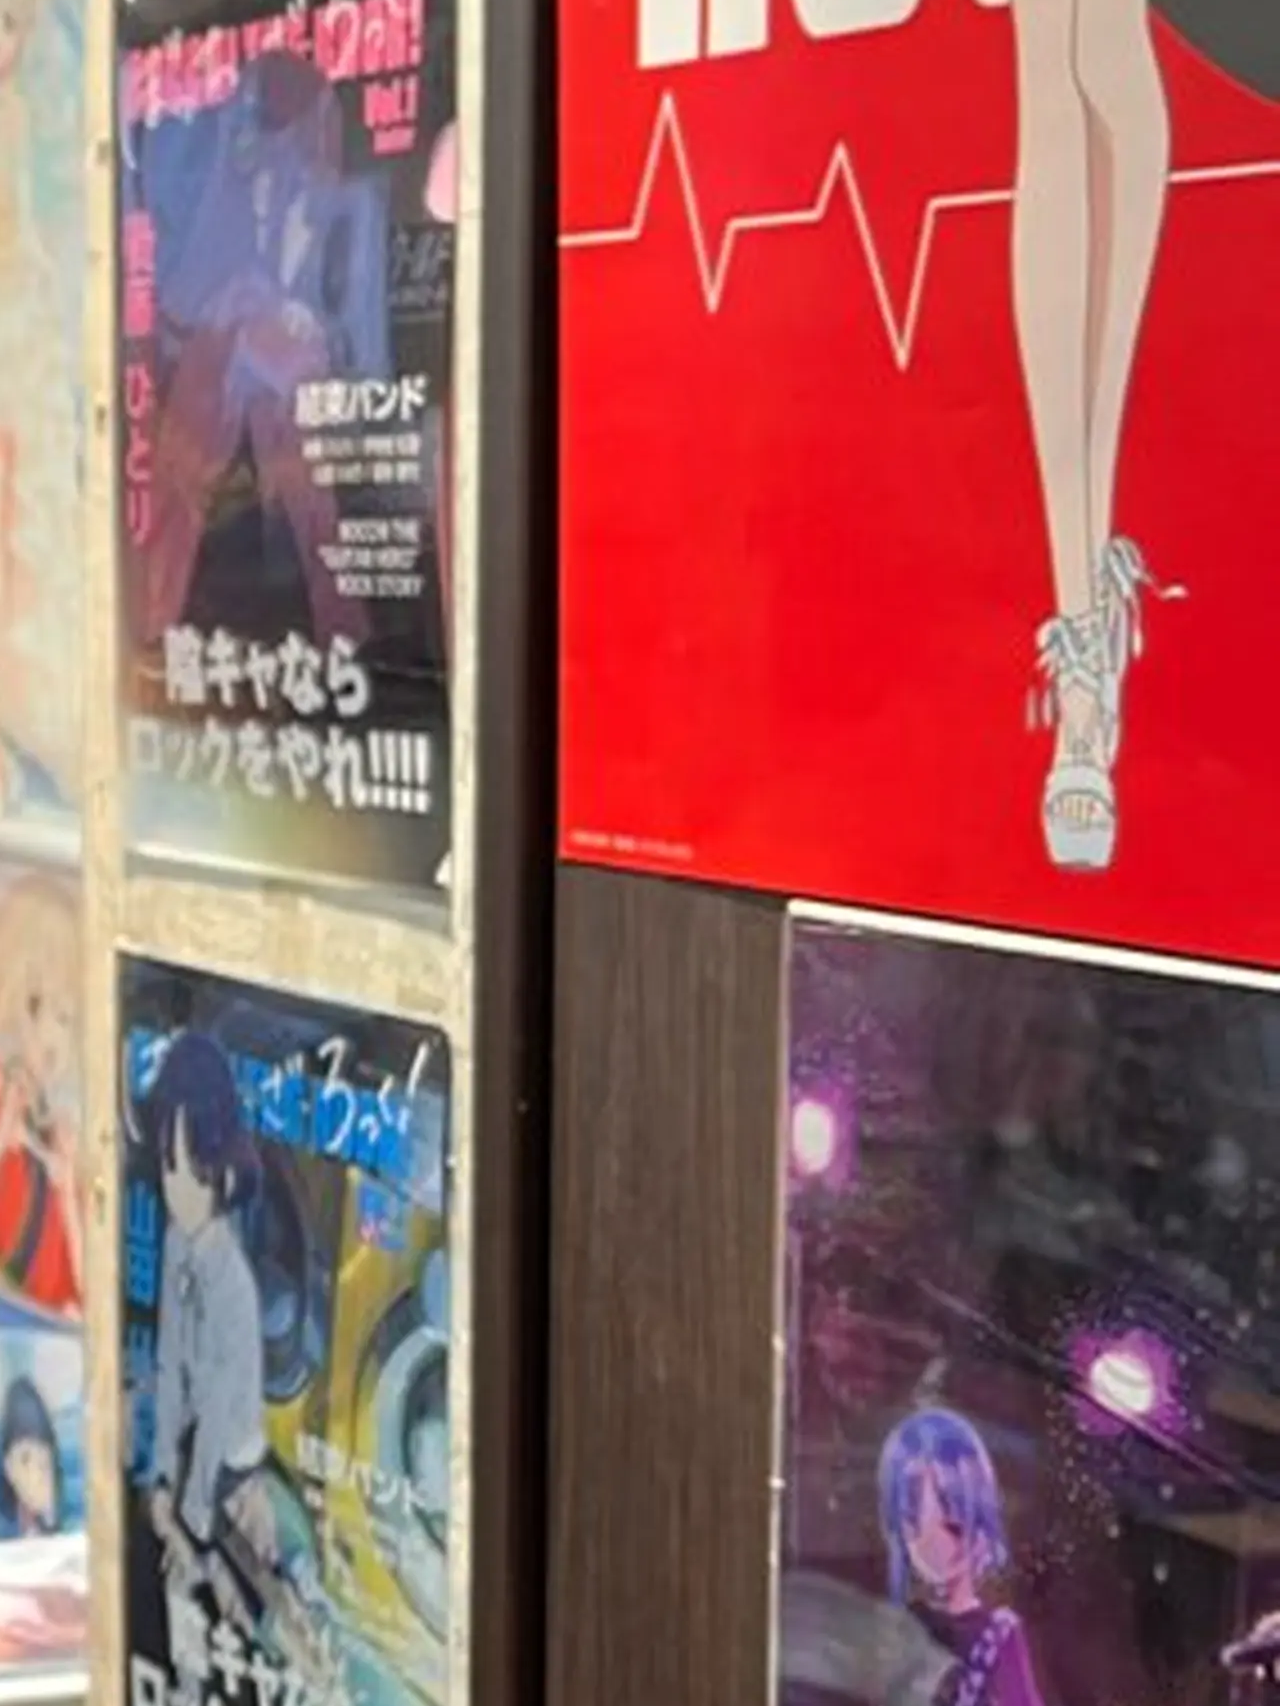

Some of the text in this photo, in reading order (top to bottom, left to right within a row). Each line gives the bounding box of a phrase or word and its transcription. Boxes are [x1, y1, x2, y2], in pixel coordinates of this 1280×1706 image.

[162, 621, 368, 717] 陰キャなら
